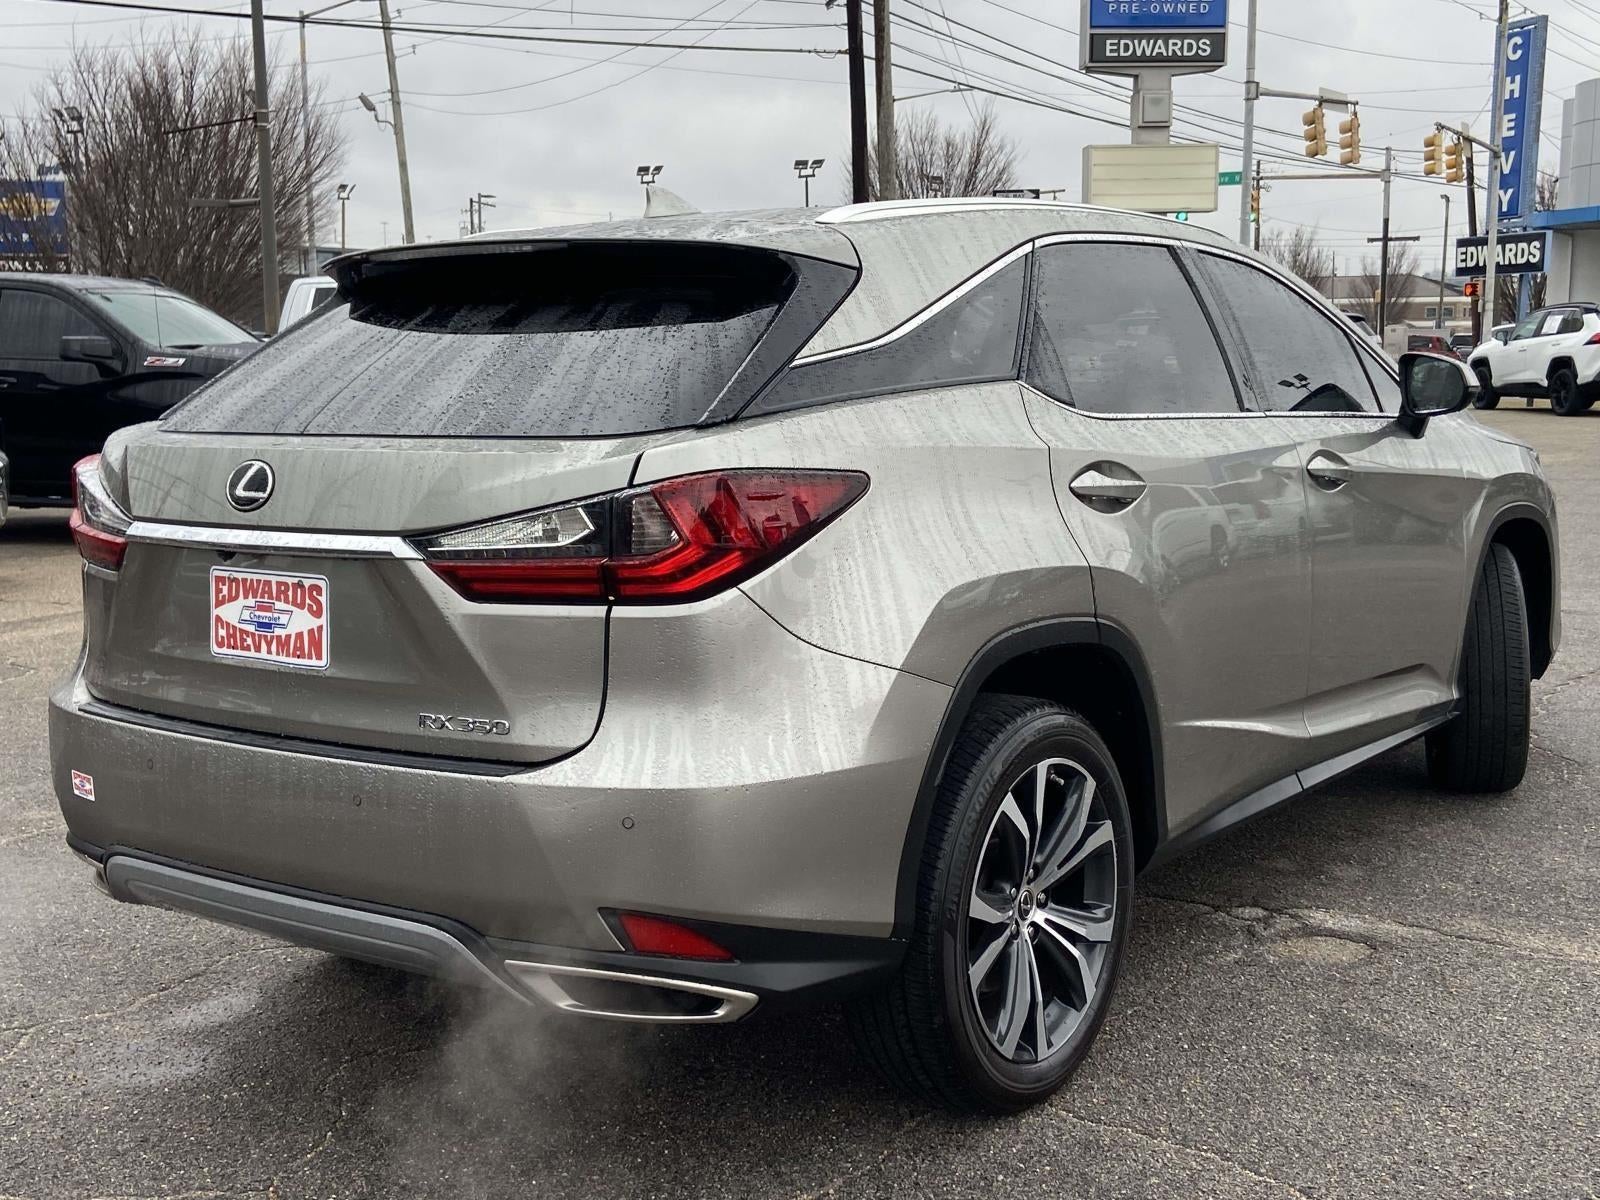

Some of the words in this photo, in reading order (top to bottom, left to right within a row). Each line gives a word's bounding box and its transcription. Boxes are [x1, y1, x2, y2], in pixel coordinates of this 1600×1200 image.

[1108, 3, 1209, 14] PRE-OWNED
[1105, 38, 1211, 57] EDWARDS
[1498, 36, 1523, 212] CHEVY
[214, 575, 323, 619] EDWARDS
[249, 610, 281, 623] Chevrolet
[214, 614, 323, 660] CHEVYMAN
